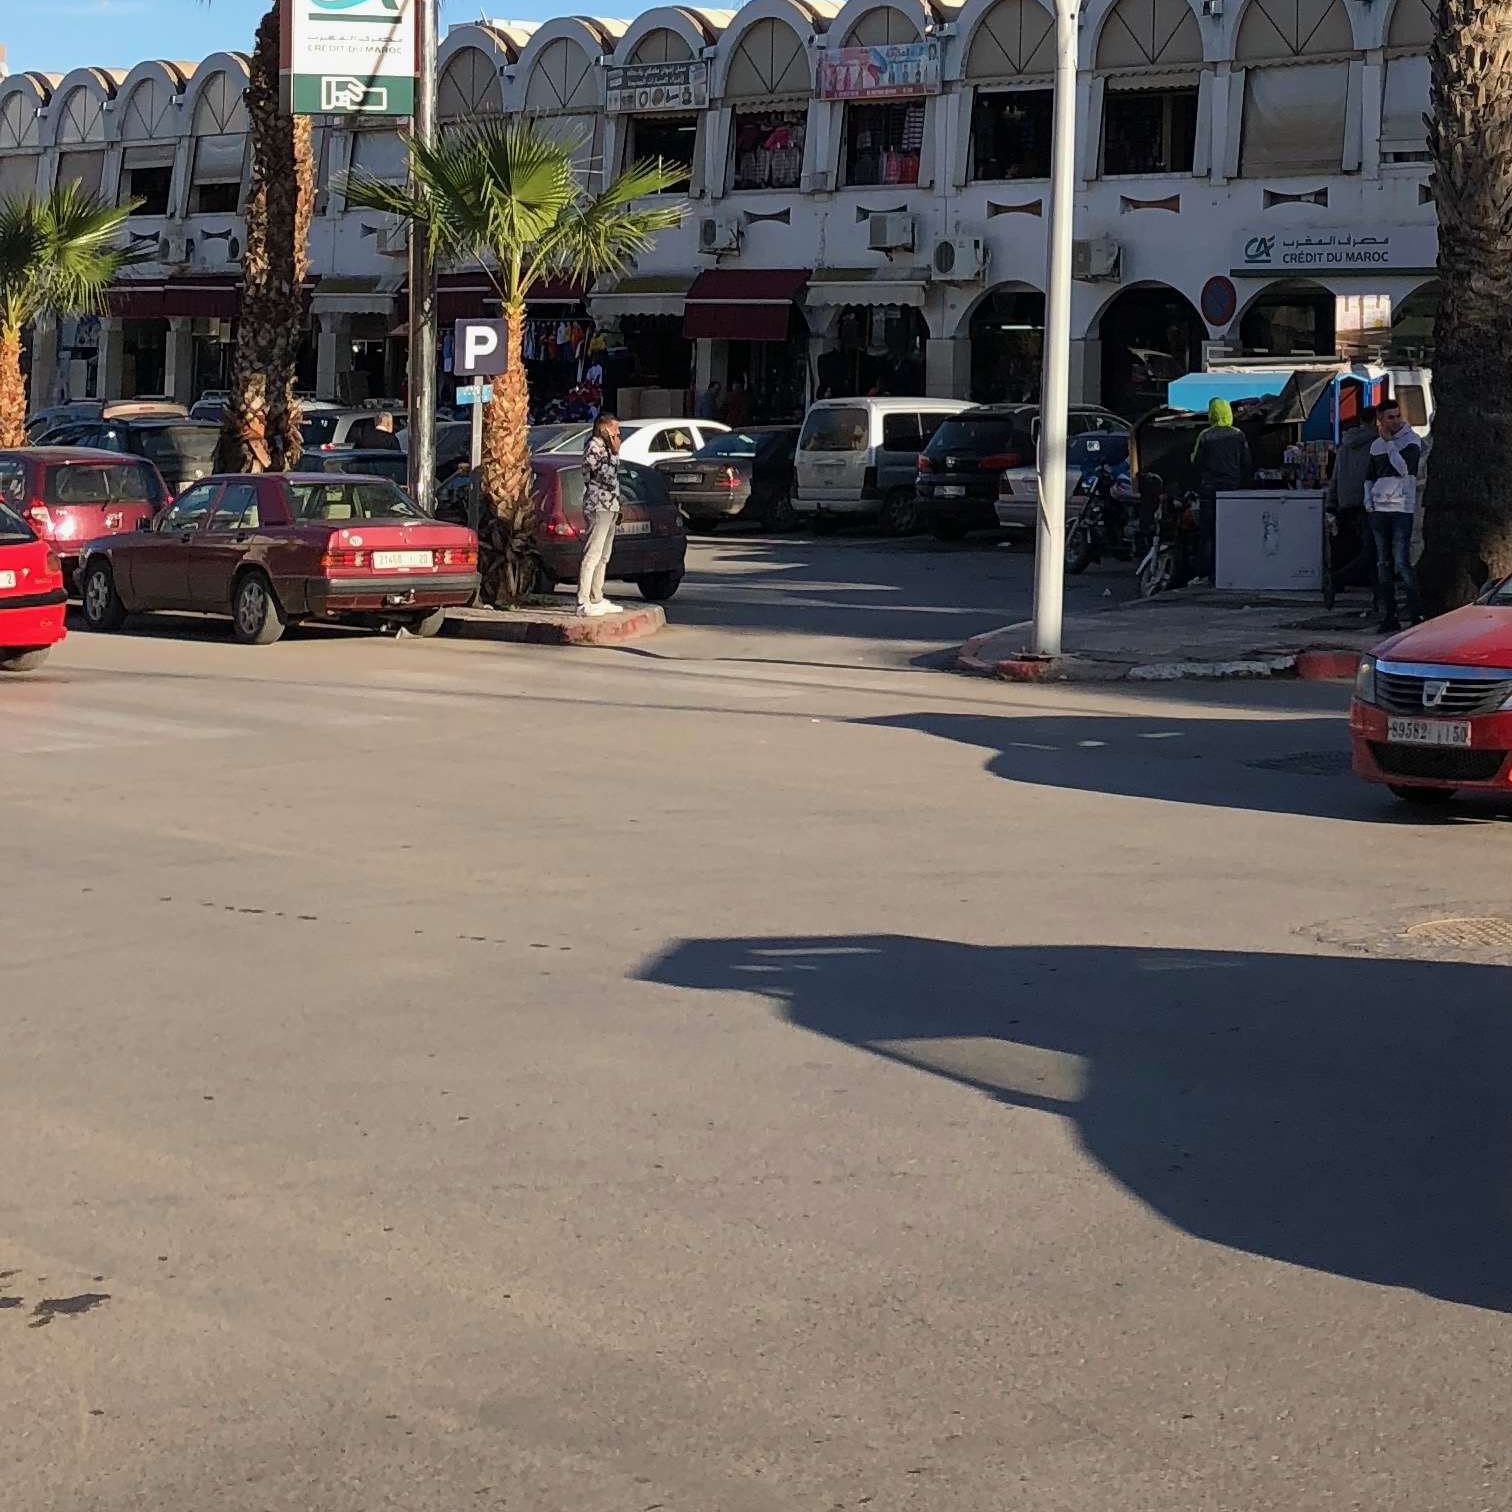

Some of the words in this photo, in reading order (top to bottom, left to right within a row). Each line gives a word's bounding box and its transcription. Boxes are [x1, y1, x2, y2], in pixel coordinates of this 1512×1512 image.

[1282, 235, 1336, 249] المغرب
[1337, 233, 1389, 248] مصرف
[1282, 251, 1323, 263] CRÉDIT
[1326, 253, 1343, 263] DU
[1346, 251, 1389, 262] MAROC
[464, 325, 498, 369] P
